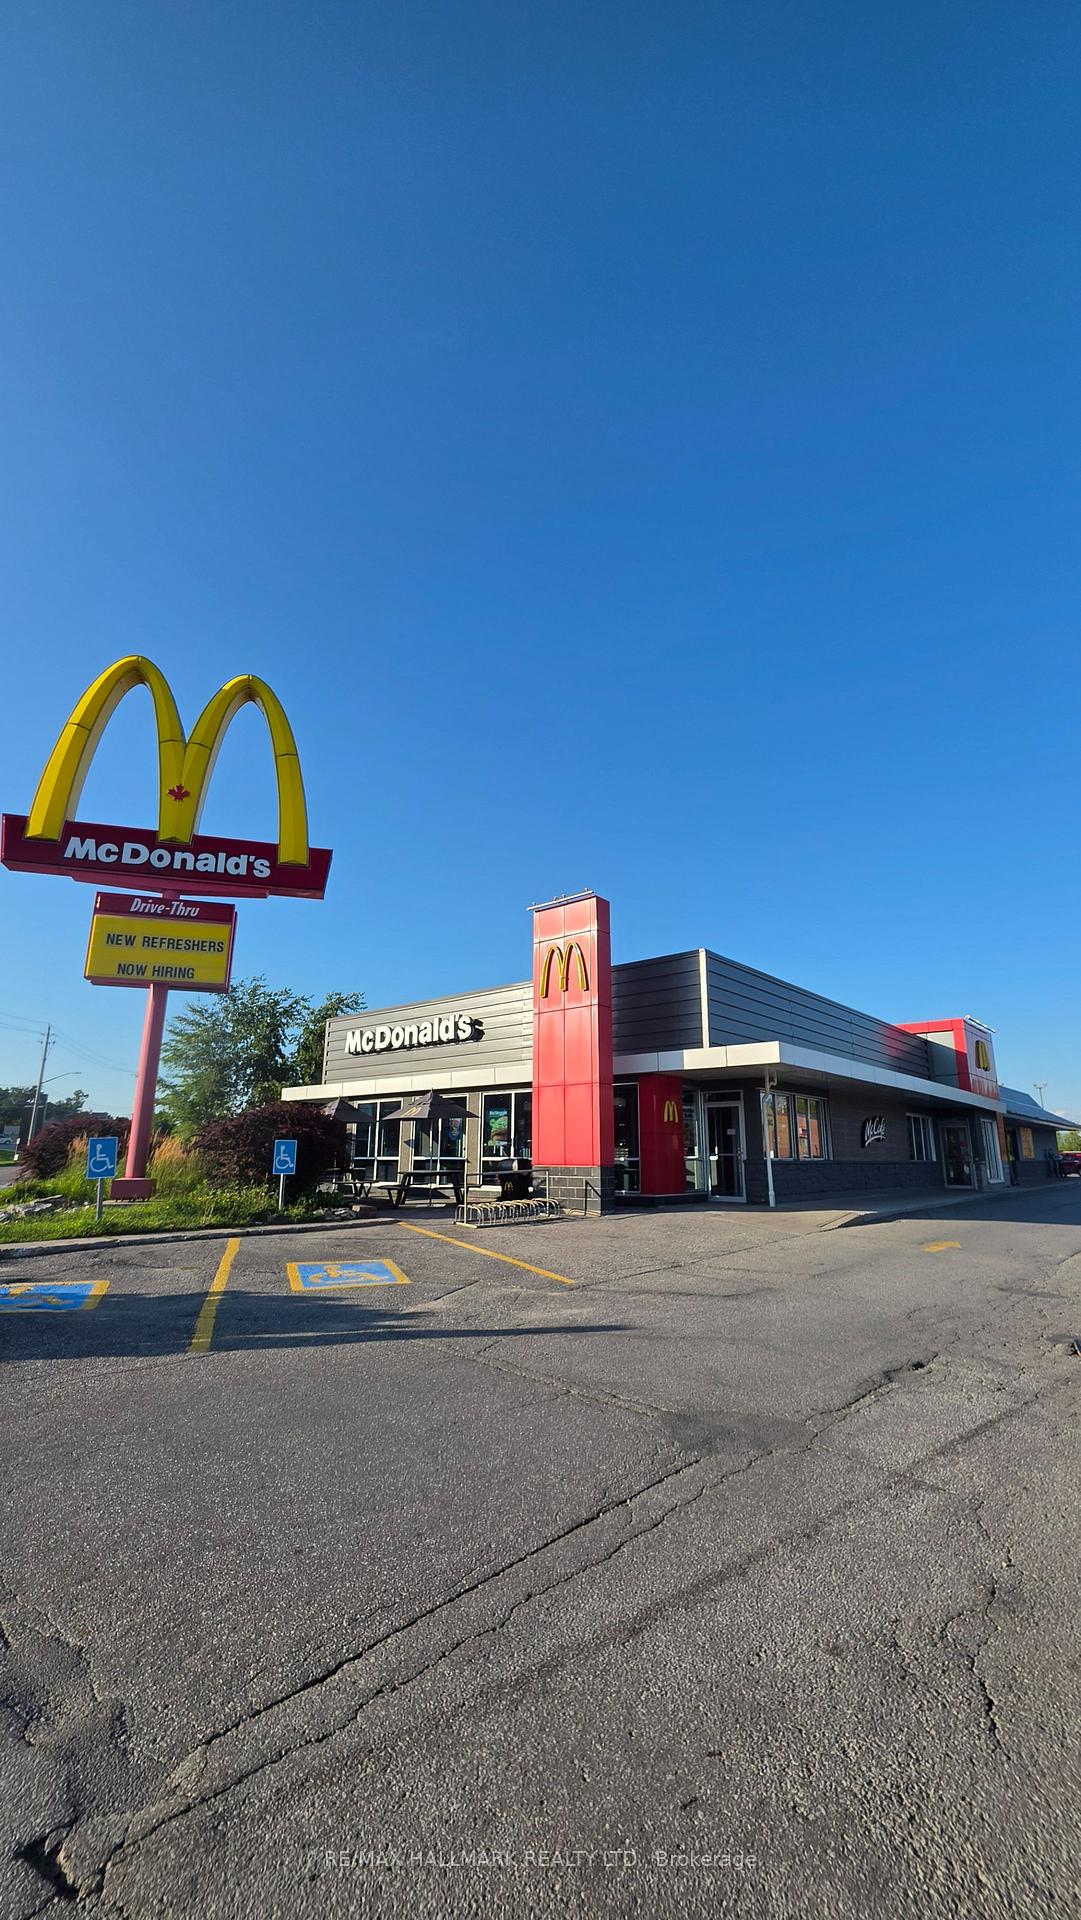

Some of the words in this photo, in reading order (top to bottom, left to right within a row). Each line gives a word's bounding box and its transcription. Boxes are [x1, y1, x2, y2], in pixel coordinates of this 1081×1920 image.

[64, 836, 272, 878] McDonald's
[129, 897, 200, 917] Drive-Thru
[106, 932, 136, 946] NEW
[142, 935, 224, 953] REFRESHERS
[116, 963, 147, 976] NOW
[151, 965, 195, 979] HIRING
[344, 1013, 473, 1054] McDonald's
